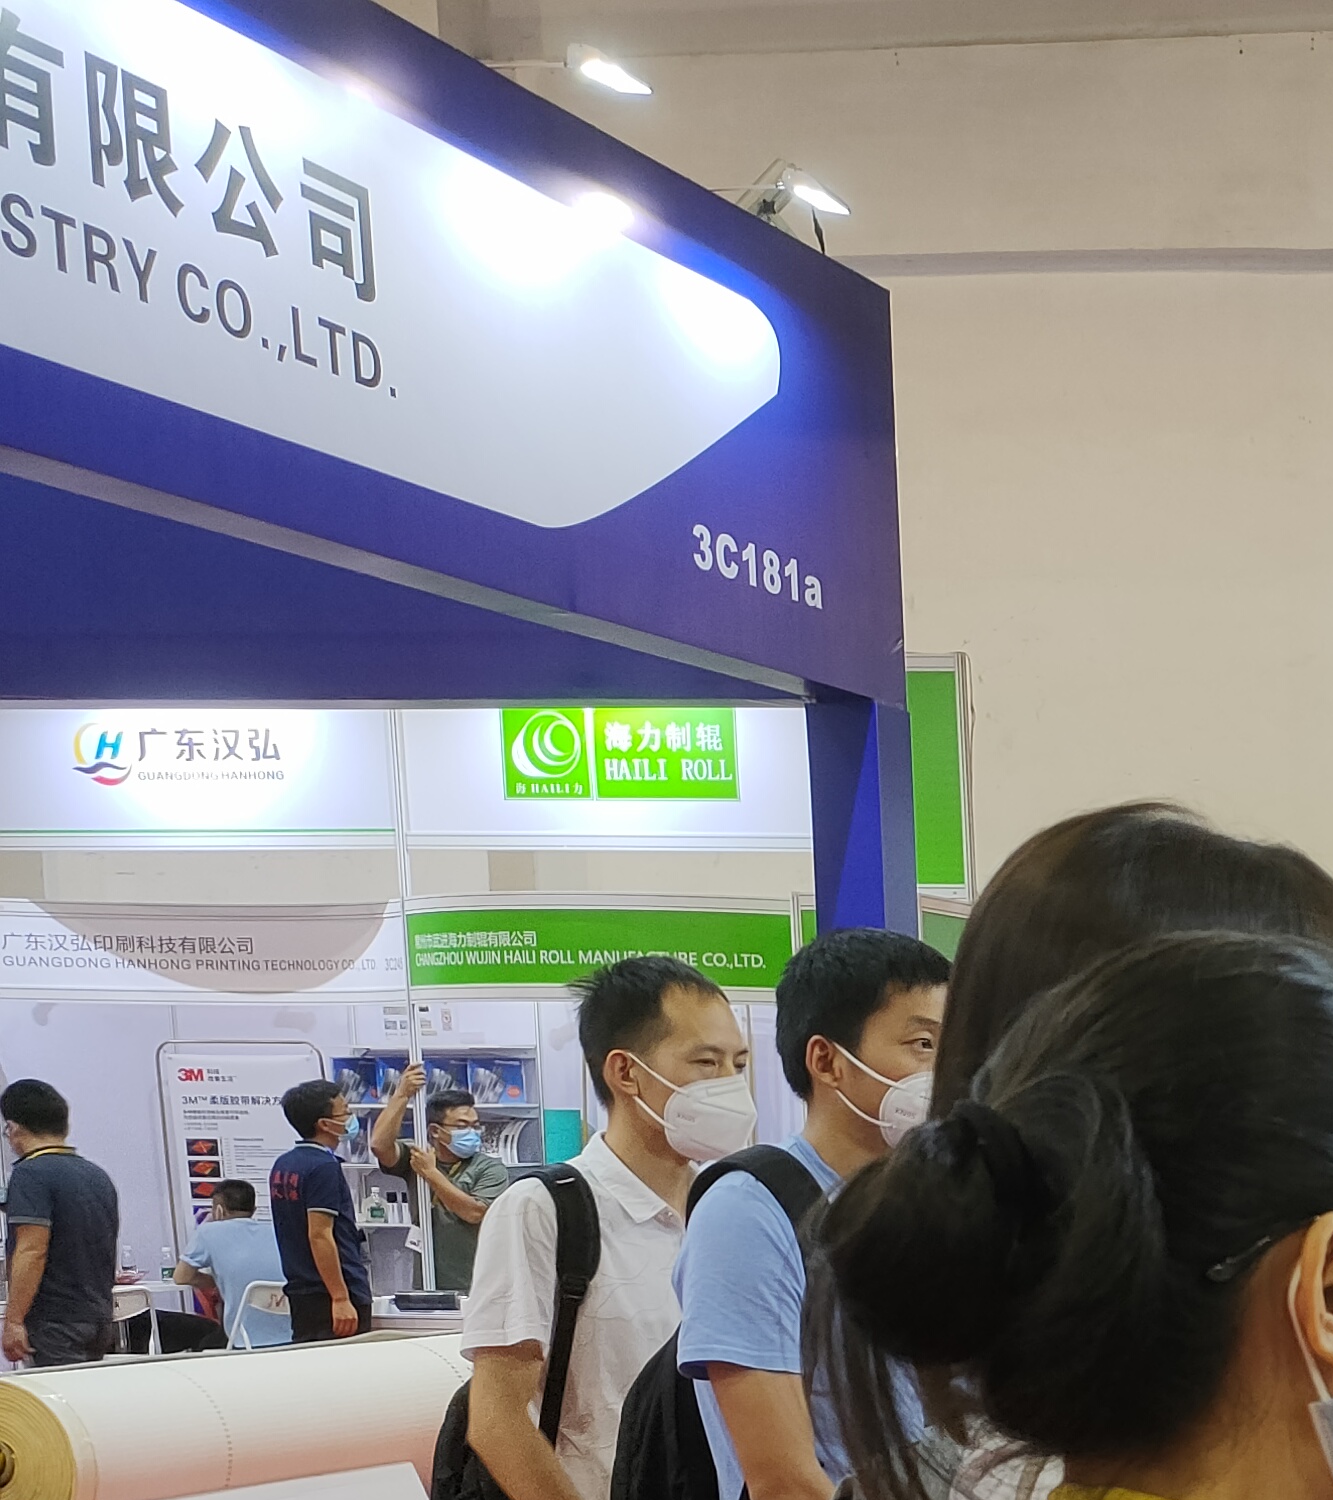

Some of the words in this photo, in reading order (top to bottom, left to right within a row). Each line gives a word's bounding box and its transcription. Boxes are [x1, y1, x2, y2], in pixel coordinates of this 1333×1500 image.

[692, 523, 823, 610] 3C181a
[138, 728, 281, 762] 广东汉弘
[603, 720, 724, 752] 海力制辊
[138, 770, 219, 781] GUANGDONG
[221, 770, 285, 781] HANHONG
[604, 758, 669, 782] HAILI
[681, 758, 733, 782] ROLL
[2, 933, 255, 955] 广东汉弘印刷科技有限公司
[2, 956, 111, 970] GUANGDONG
[114, 957, 192, 971] HANHONG
[196, 958, 261, 972] PRINTING
[264, 958, 340, 972] TECHNOLOGY
[466, 950, 501, 965] WUJIN
[504, 950, 536, 965] HAILI
[540, 950, 575, 965] ROLL
[177, 1068, 205, 1082] 3M
